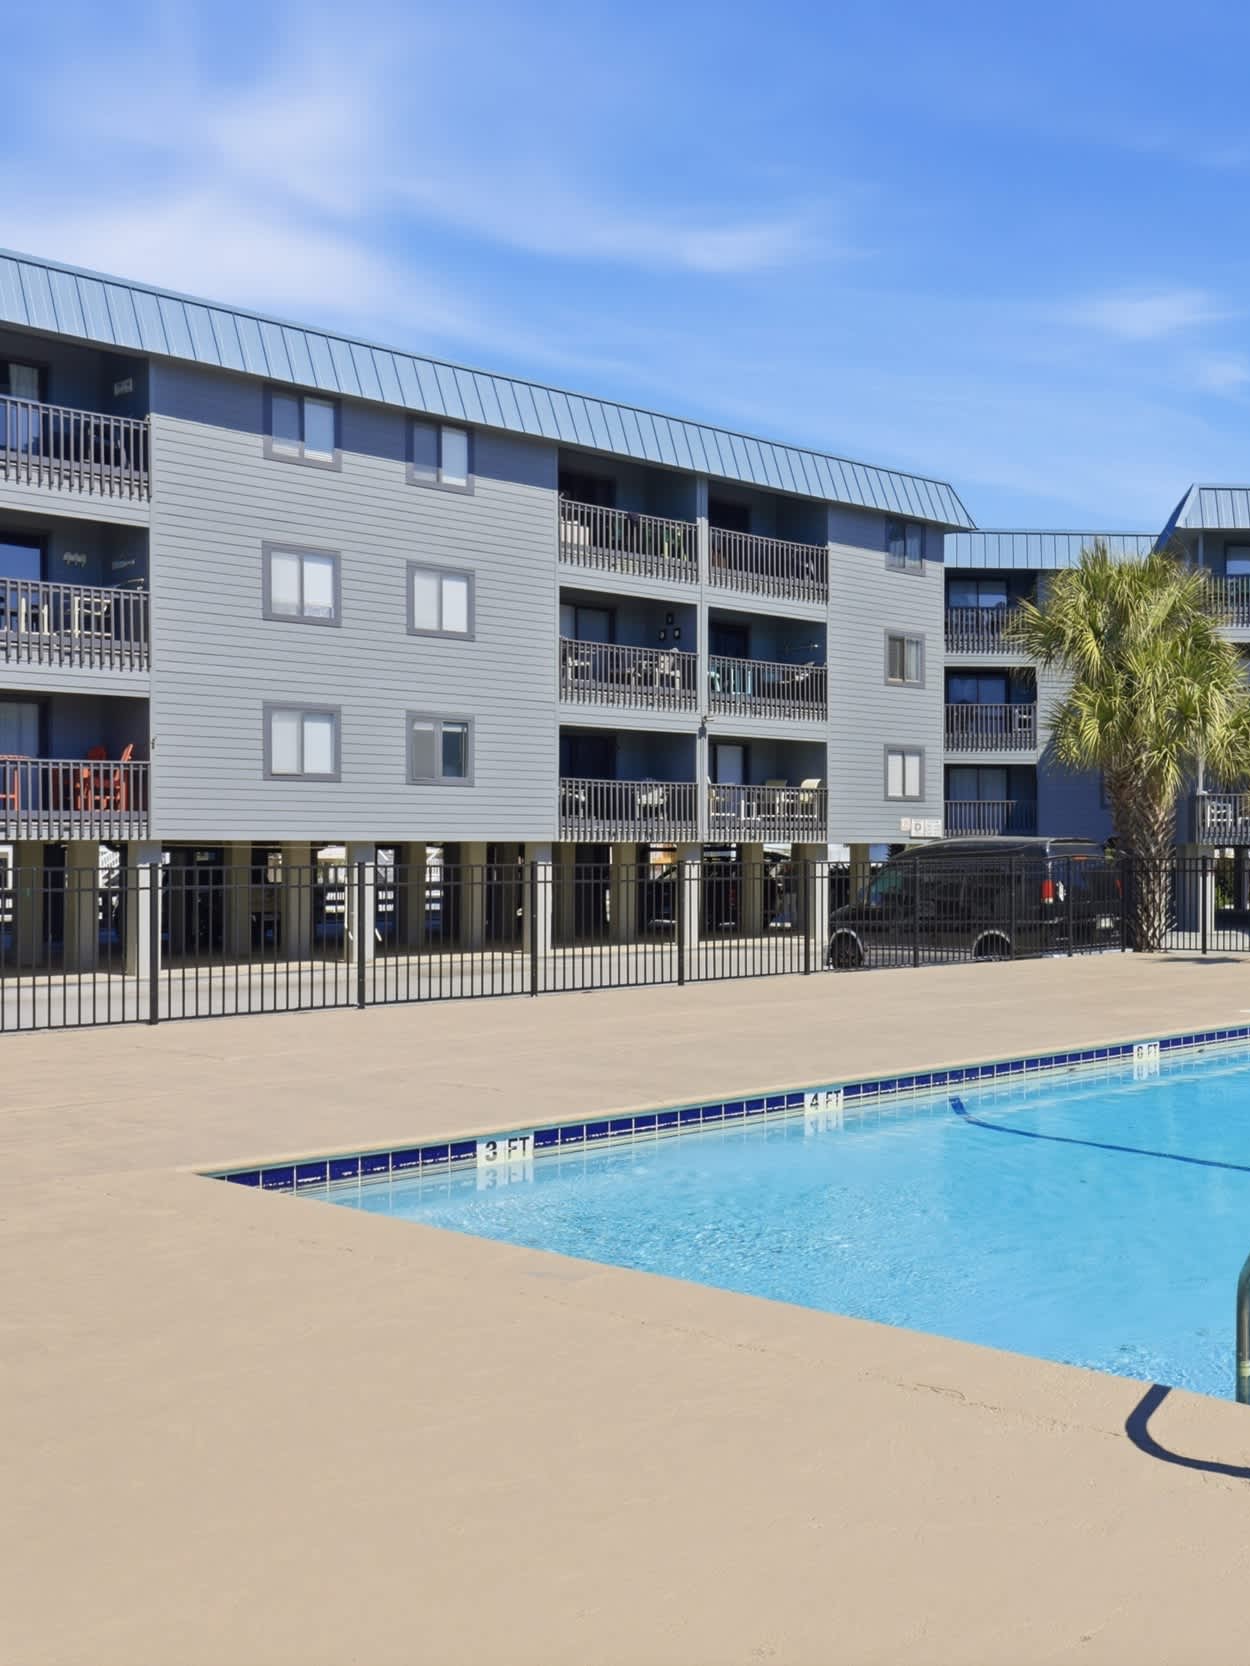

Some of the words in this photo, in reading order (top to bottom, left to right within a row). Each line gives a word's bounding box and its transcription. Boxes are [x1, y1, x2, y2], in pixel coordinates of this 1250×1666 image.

[810, 1093, 819, 1110] 4
[826, 1090, 841, 1109] FT
[485, 1141, 497, 1161] 3
[508, 1136, 530, 1159] FT
